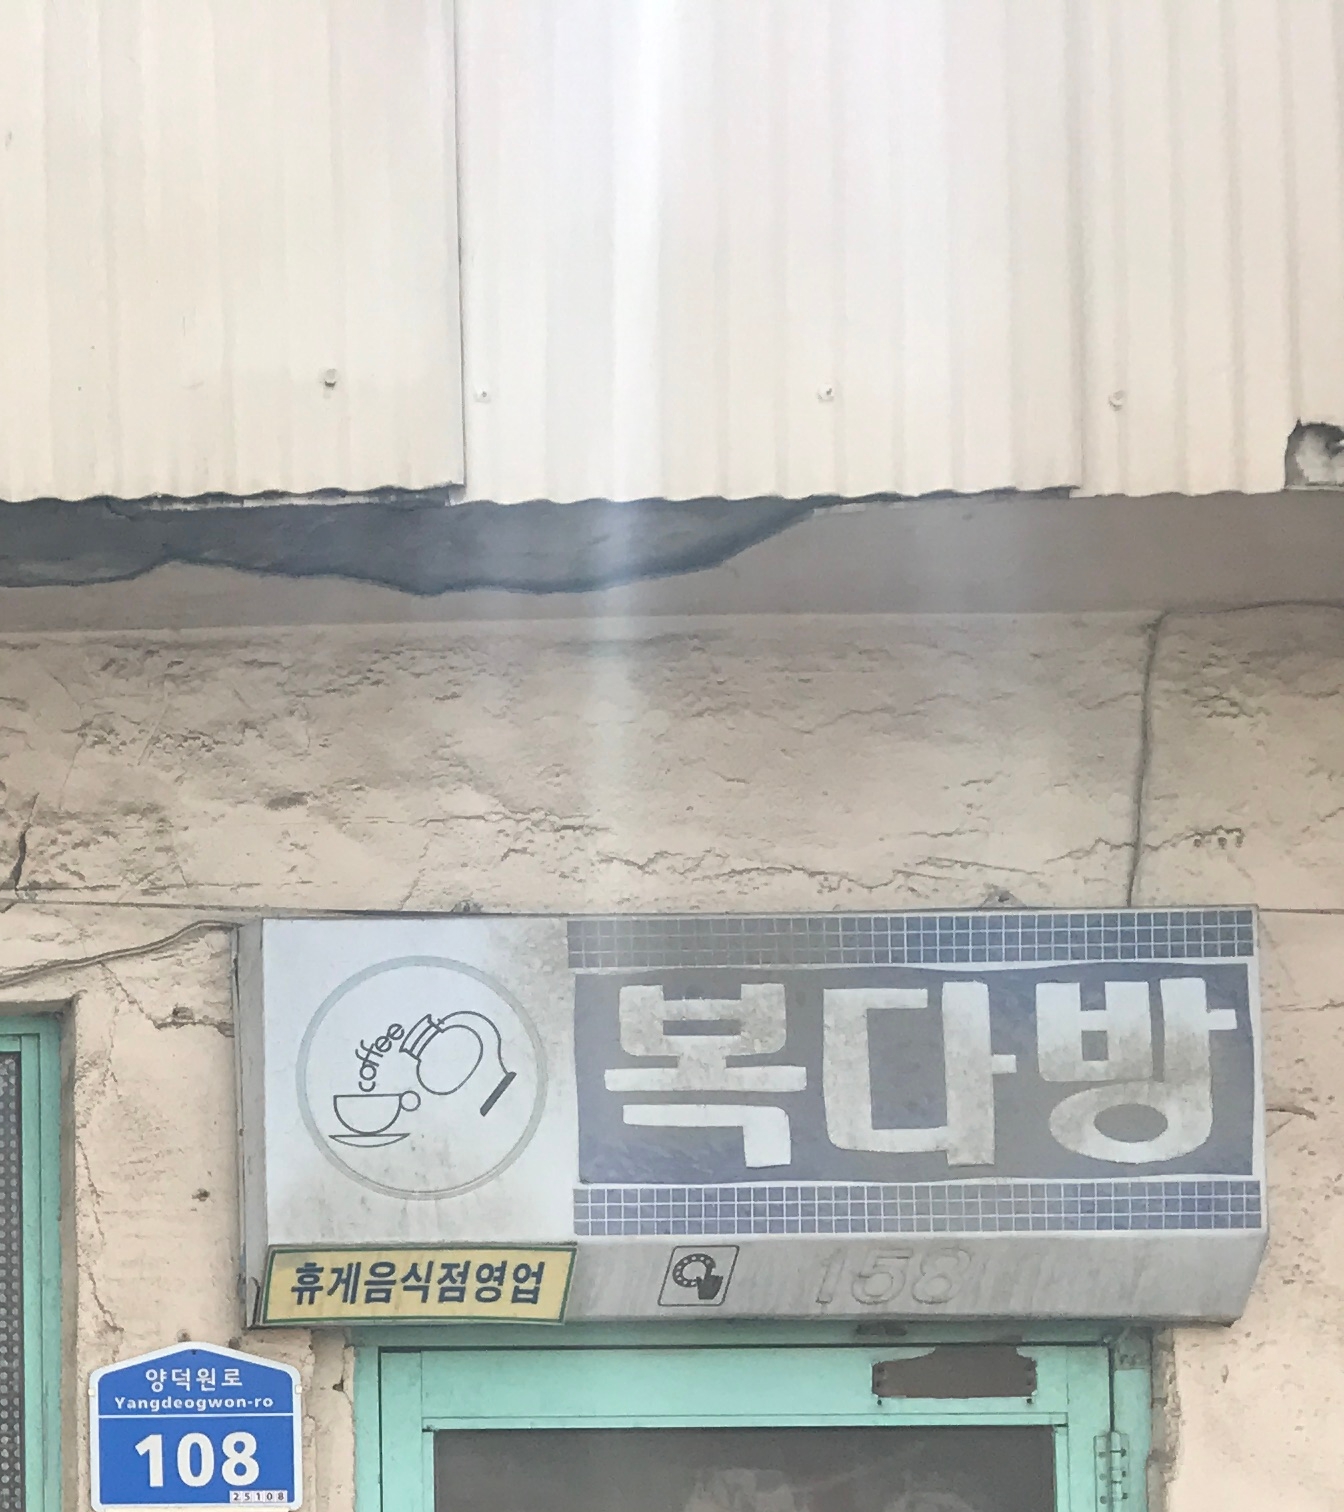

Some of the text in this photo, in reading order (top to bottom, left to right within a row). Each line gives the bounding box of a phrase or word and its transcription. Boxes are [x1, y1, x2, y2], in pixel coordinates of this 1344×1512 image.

[354, 1023, 405, 1092] coffee
[603, 977, 1238, 1168] 복다방
[290, 1259, 546, 1306] 휴게음식점영업
[145, 1367, 243, 1393] 양덕원로
[114, 1396, 274, 1412] Yangdeogwon-ro
[135, 1431, 260, 1487] 108
[232, 1492, 285, 1501] 25108
